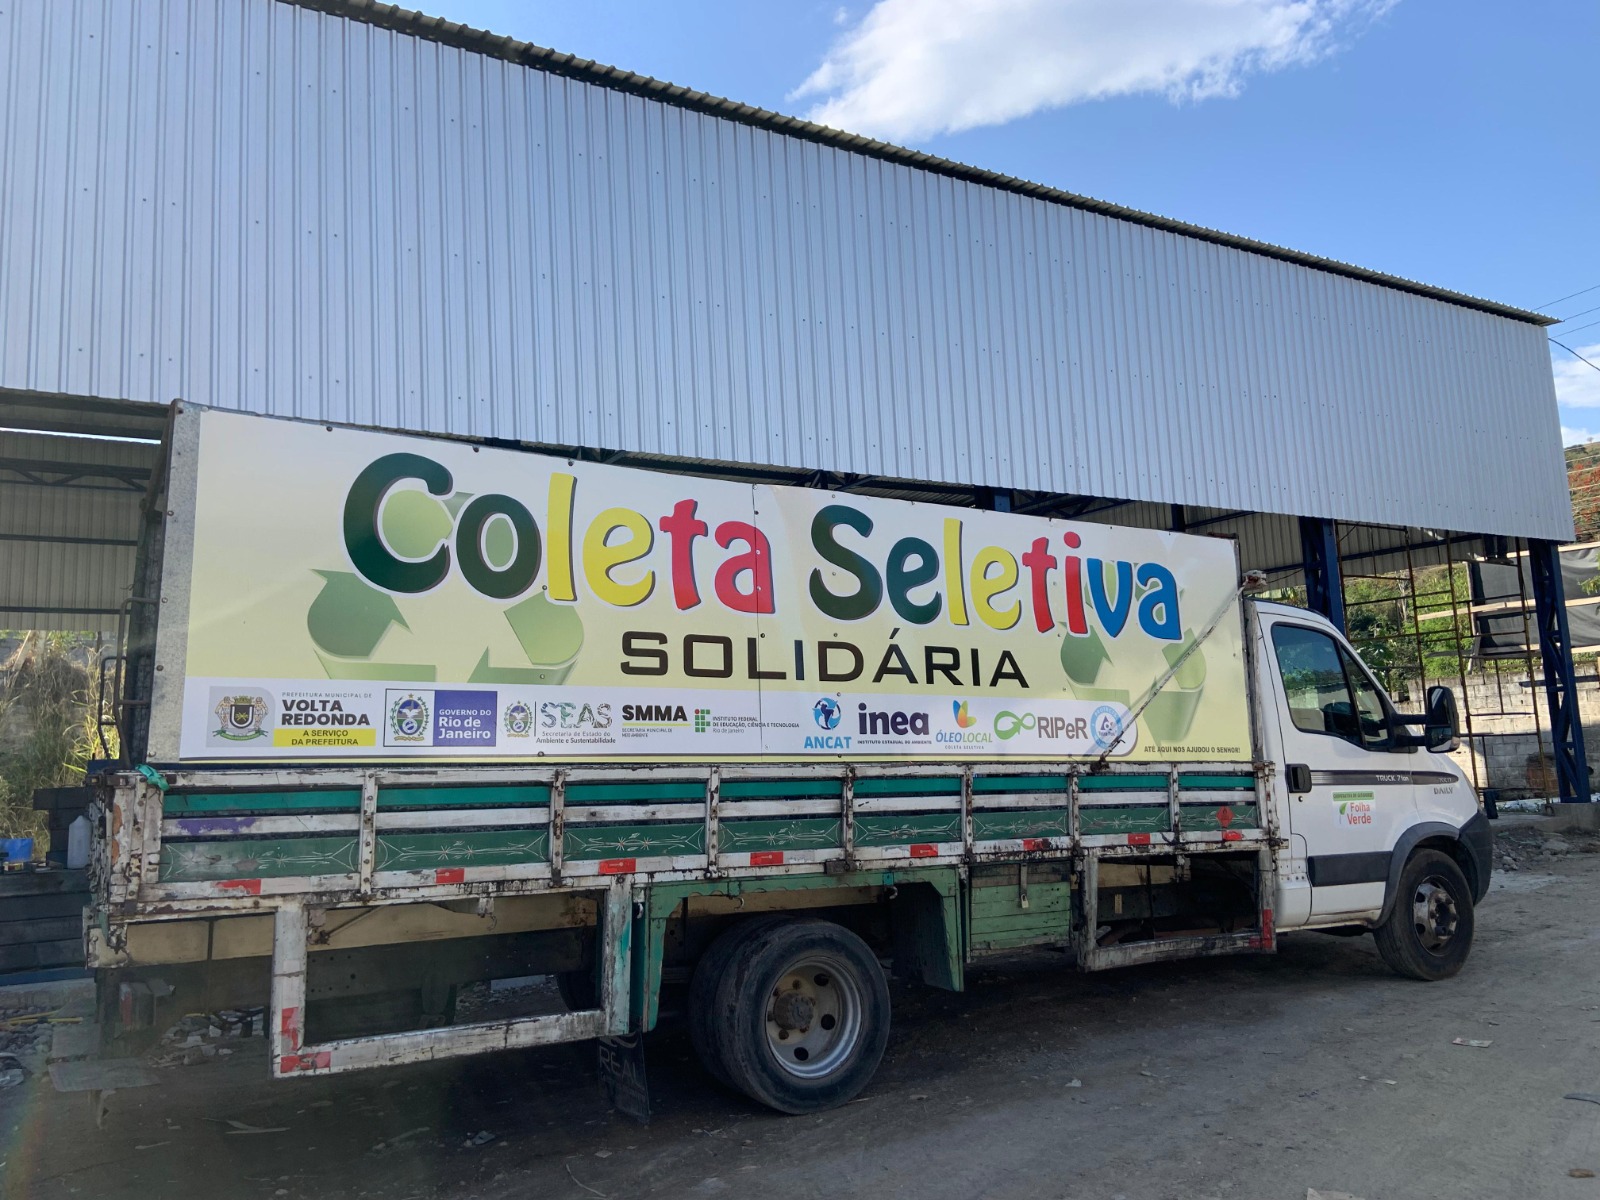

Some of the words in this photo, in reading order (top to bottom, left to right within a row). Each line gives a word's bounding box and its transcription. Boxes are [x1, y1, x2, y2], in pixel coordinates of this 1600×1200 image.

[343, 452, 776, 614] Coleta
[809, 504, 1183, 641] Seletiva
[620, 627, 1030, 689] SOLIDÁRIA
[281, 699, 344, 712] VOLTA
[438, 708, 478, 716] GOVERNO
[281, 713, 371, 726] REDONDA
[540, 701, 613, 729] SEAS
[621, 704, 688, 722] SMMA
[858, 702, 930, 736] inea
[438, 716, 462, 728] Rio
[464, 716, 481, 728] de
[1037, 716, 1089, 740] RIPeR
[302, 729, 310, 737] A
[311, 729, 349, 738] SERVIÇO
[438, 728, 491, 739] Janeiro
[291, 738, 304, 746] DA
[305, 738, 359, 746] PREFEITURA
[803, 736, 852, 749] ANCAT
[1143, 744, 1156, 753] ATÉ
[1433, 787, 1454, 795] DAILY
[1350, 802, 1371, 812] Folha
[1346, 812, 1372, 825] Verde
